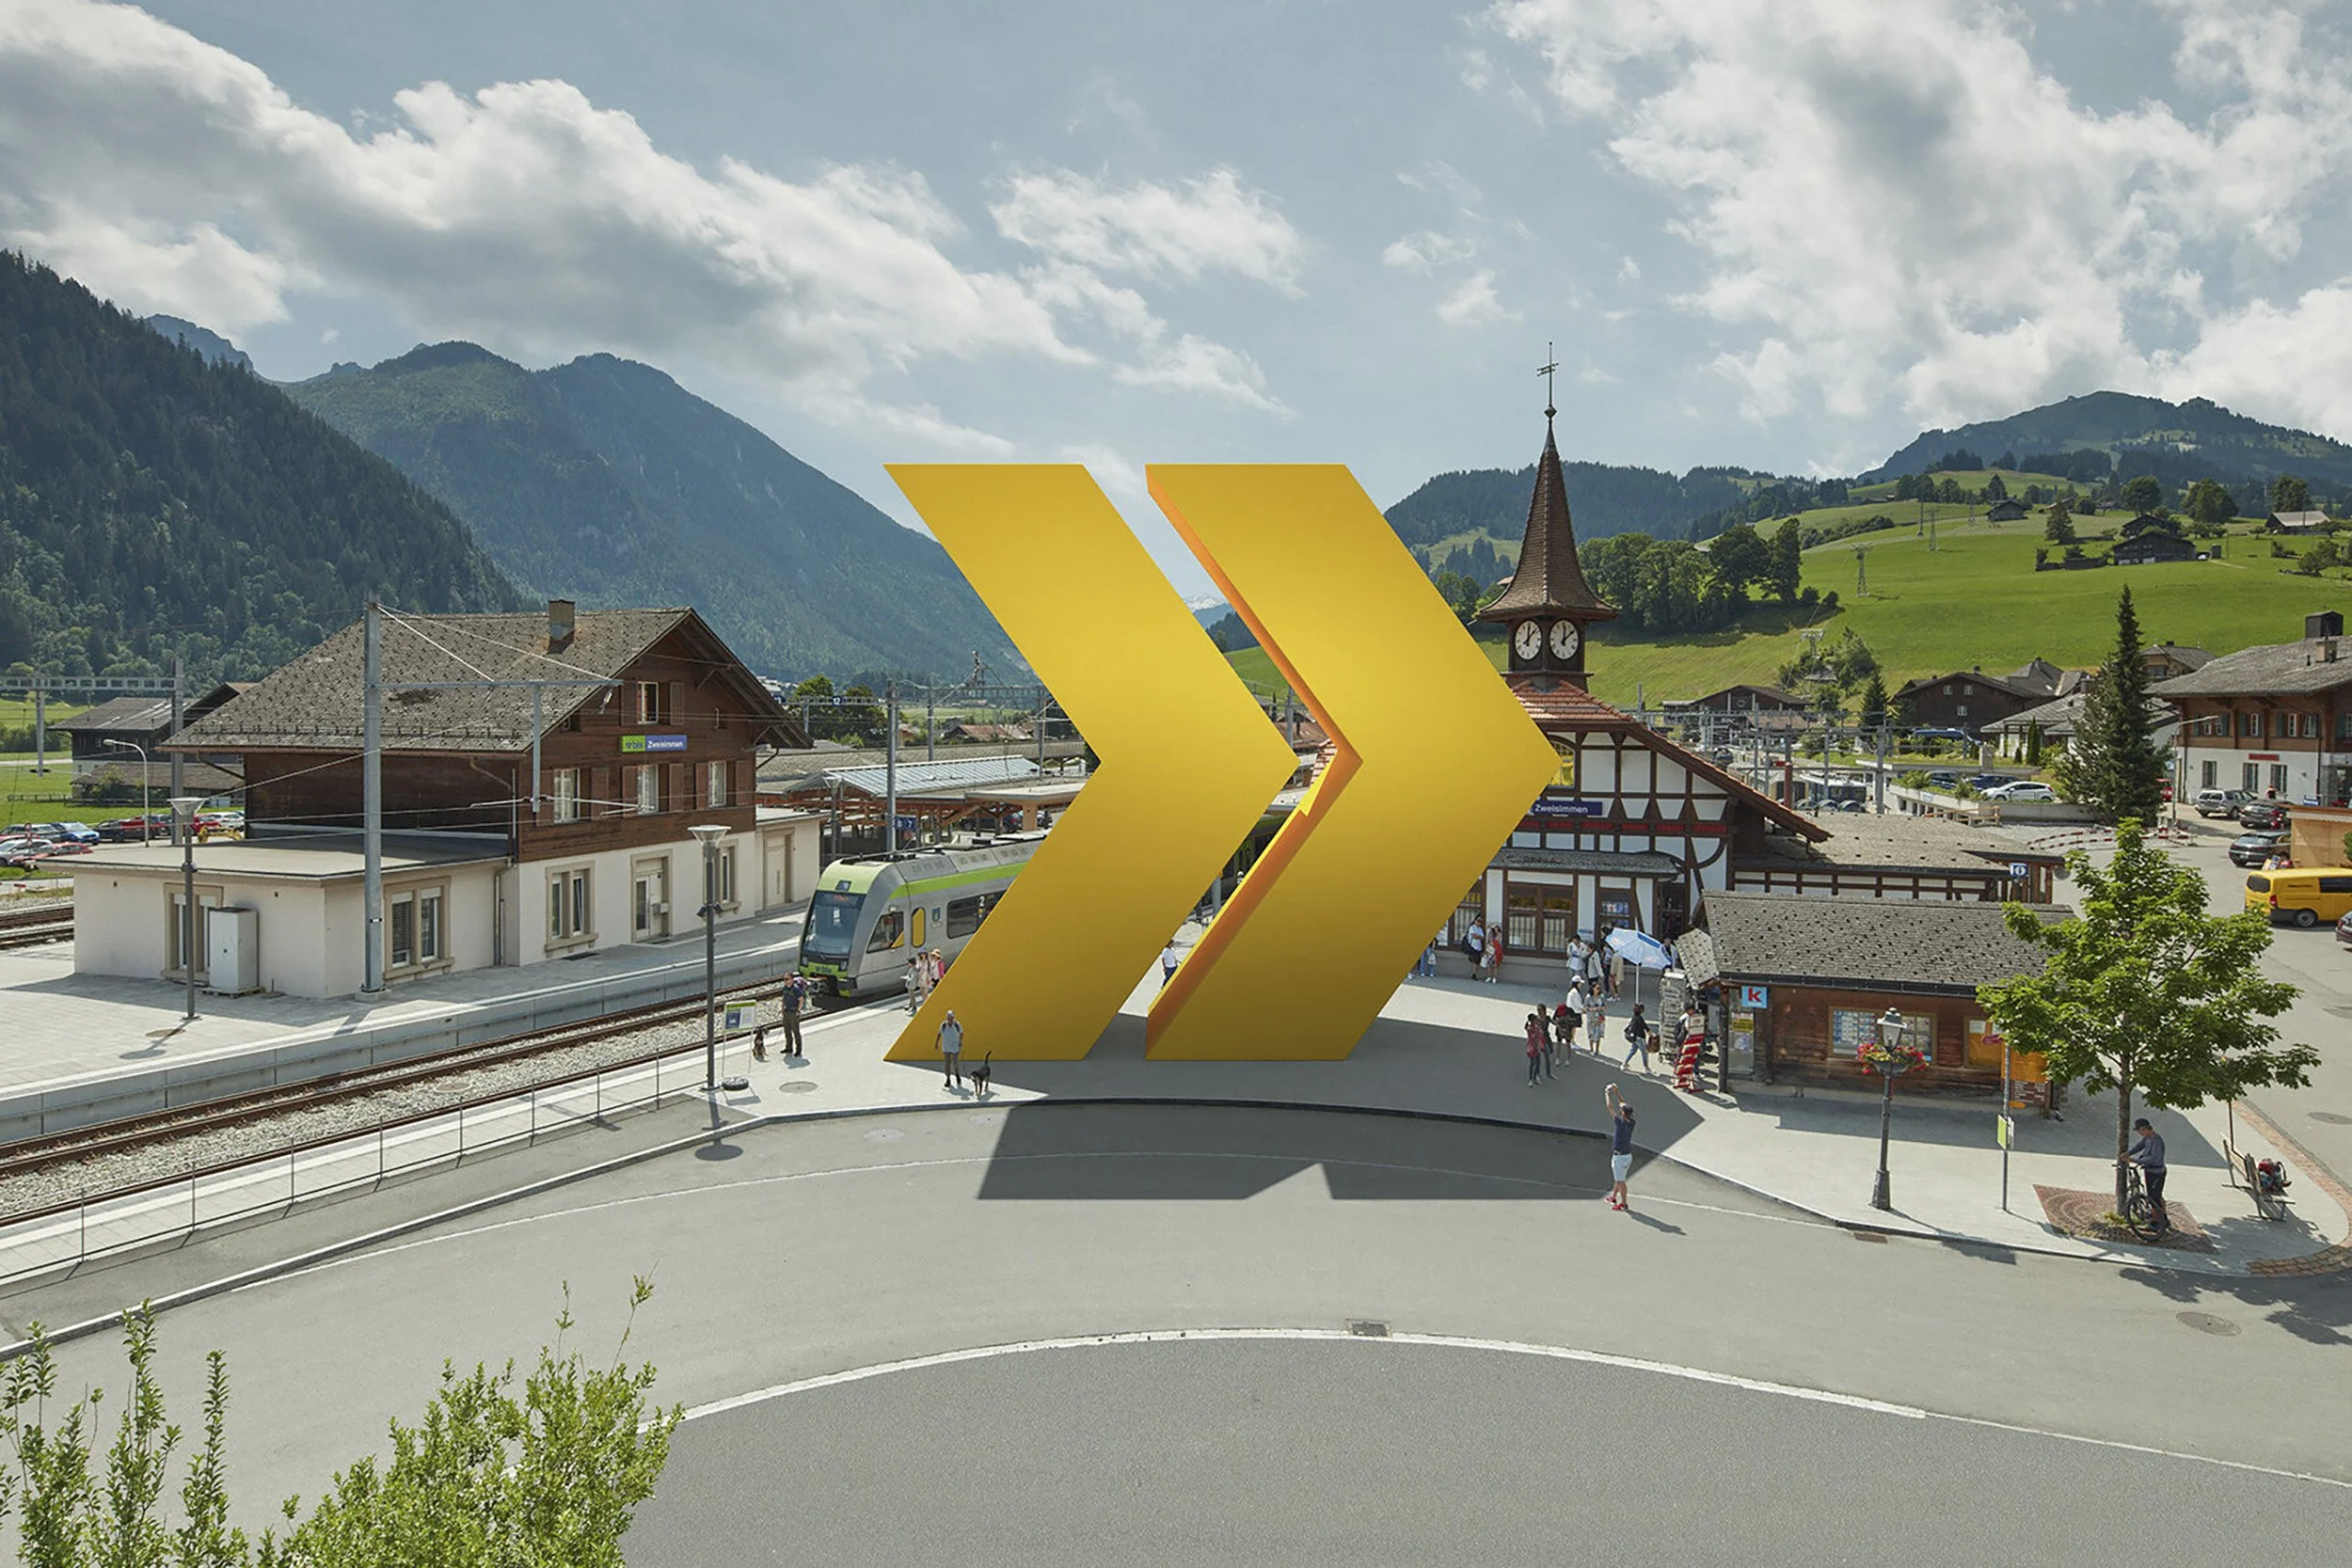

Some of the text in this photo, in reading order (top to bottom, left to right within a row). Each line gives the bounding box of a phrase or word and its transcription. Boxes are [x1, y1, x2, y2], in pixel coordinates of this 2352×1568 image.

[832, 696, 841, 705] 12
[647, 740, 683, 749] Zweisimmen
[1534, 804, 1588, 814] Zweisimmen
[978, 895, 985, 907] 2
